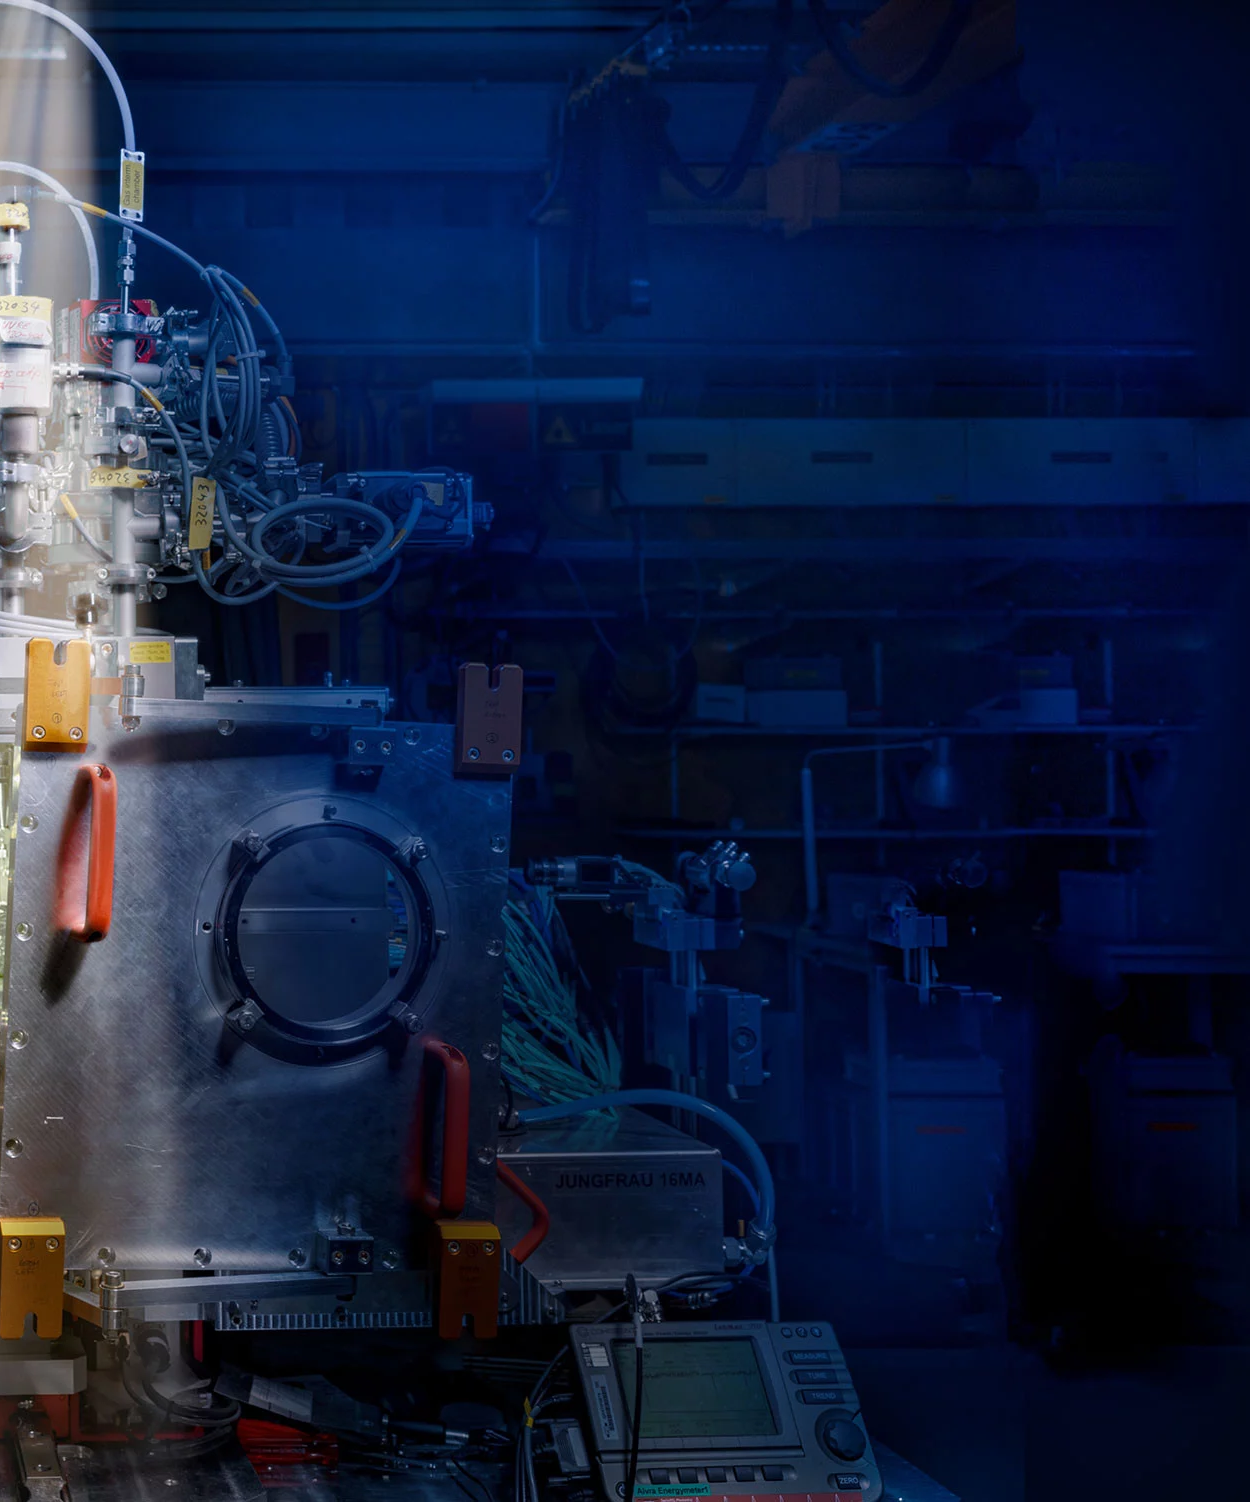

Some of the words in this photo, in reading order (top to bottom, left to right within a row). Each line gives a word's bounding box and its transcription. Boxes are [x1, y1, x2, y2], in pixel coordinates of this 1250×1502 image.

[194, 484, 210, 526] 32043
[555, 1171, 654, 1189] JUNGFRAU
[659, 1171, 706, 1188] 16MA
[793, 1352, 828, 1360] MEASURE
[811, 1392, 837, 1400] TREND
[837, 1476, 859, 1485] ZERO
